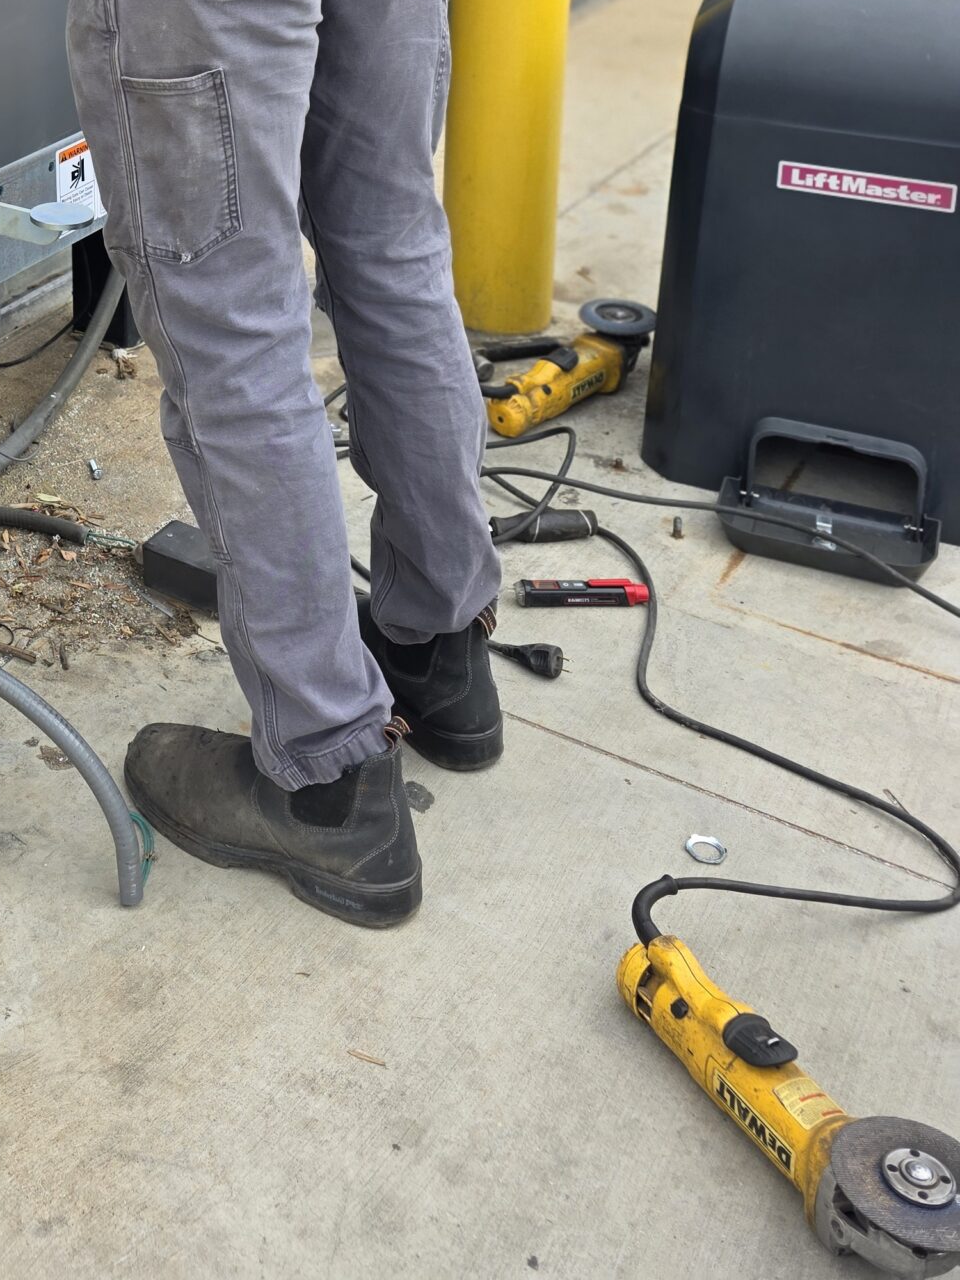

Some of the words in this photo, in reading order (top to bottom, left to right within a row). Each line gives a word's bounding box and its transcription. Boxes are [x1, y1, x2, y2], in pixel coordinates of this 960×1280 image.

[68, 145, 88, 158] WARNIN
[790, 168, 942, 205] LiftMaster
[716, 1080, 791, 1172] DEWALT
